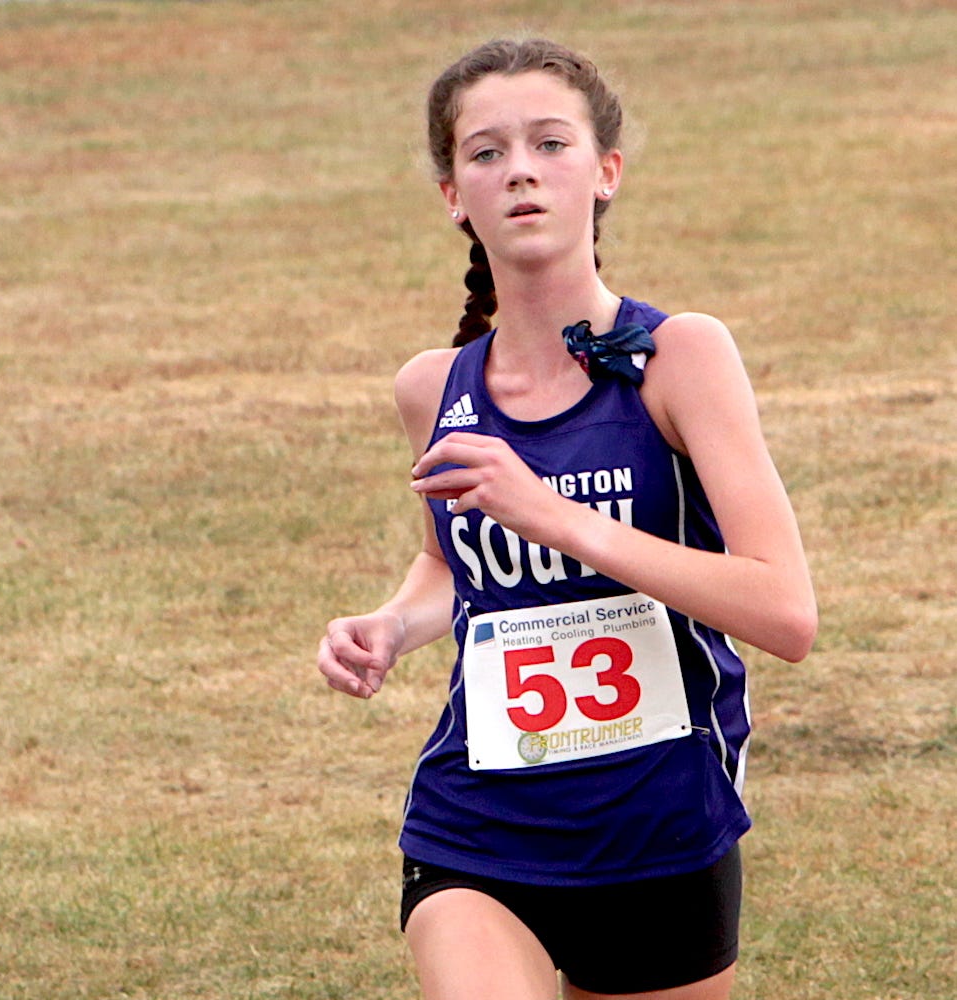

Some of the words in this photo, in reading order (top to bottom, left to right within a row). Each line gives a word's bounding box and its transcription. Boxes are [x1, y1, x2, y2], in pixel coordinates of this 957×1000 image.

[438, 414, 479, 429] adidas
[450, 498, 633, 591] SOU
[499, 610, 590, 634] Commercial
[595, 600, 655, 621] Service
[503, 634, 543, 647] Heating
[551, 627, 595, 642] Cooling
[603, 616, 656, 634] Plumbing
[503, 636, 642, 733] 53
[530, 716, 643, 752] FRONTRUNNER
